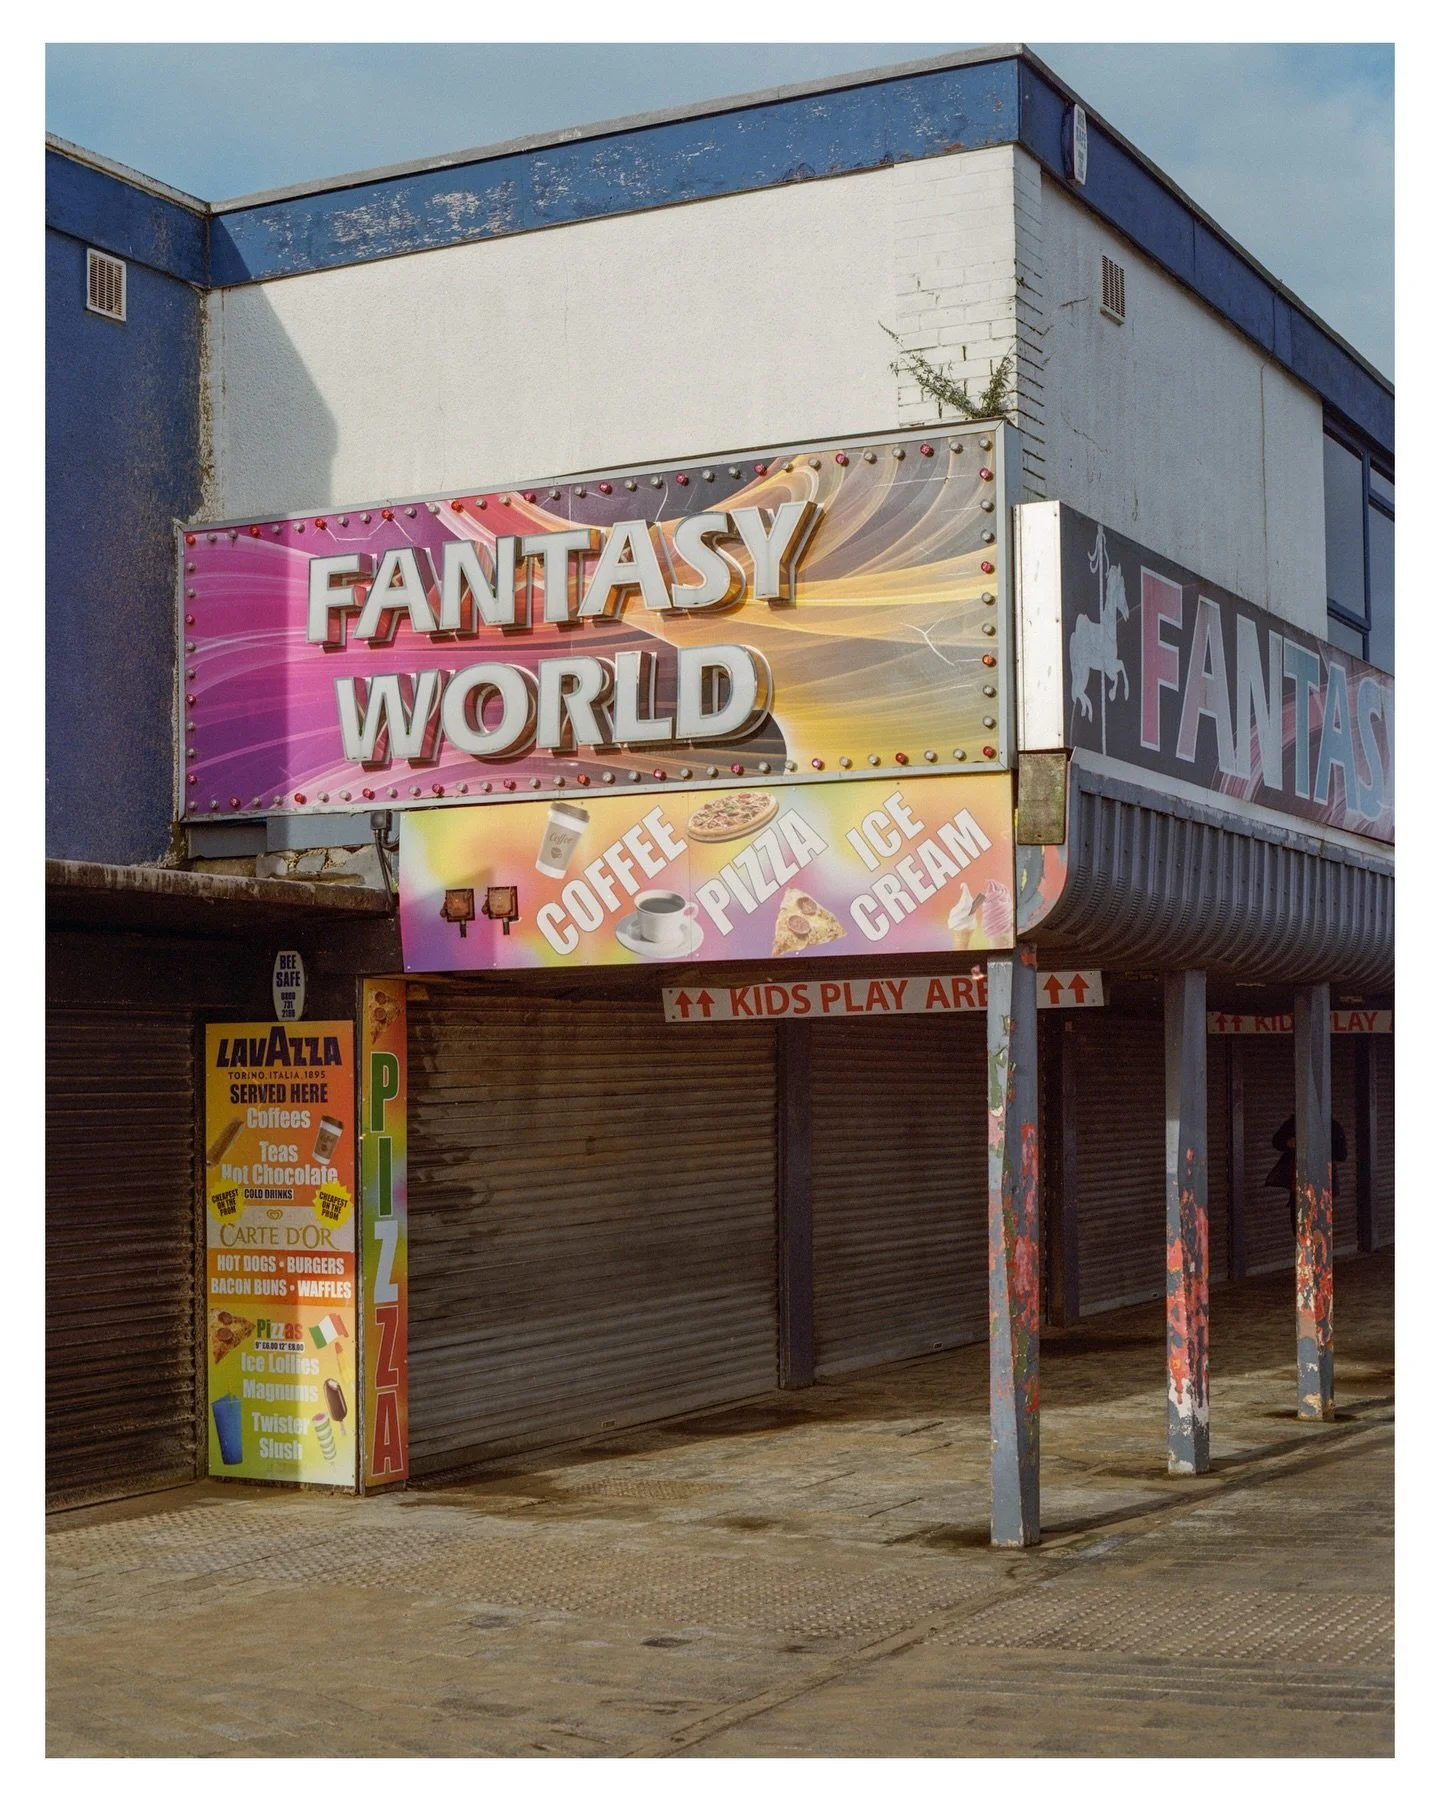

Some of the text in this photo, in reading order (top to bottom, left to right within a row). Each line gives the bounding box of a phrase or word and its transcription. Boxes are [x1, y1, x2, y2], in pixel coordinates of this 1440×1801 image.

[306, 500, 821, 647] FANTASY
[334, 643, 773, 766] WORLD
[549, 831, 574, 845] Coffee
[845, 790, 926, 872] ICE
[535, 805, 689, 957] COFFEE
[694, 807, 830, 937] PIZZA
[849, 807, 994, 944] CREAM
[280, 955, 297, 969] BEE
[276, 971, 300, 987] SAFE
[729, 976, 988, 1017] KIDS PLAY ARE
[1255, 1014, 1294, 1031] KID
[1331, 1012, 1378, 1031] LAY
[216, 1026, 343, 1067] LAVAZZA
[304, 1070, 326, 1079] 1895
[230, 1083, 328, 1104] SERVED HERE
[247, 1107, 311, 1129] Coffees
[258, 1141, 298, 1162] Teas
[221, 1164, 338, 1186] Hot Chocolate
[211, 1188, 239, 1204] CHEAPEST
[217, 1198, 237, 1209] ON THE
[244, 1188, 293, 1199] COLD DRINKS
[319, 1191, 348, 1208] CHEAPEST
[220, 1206, 237, 1217] PROM
[322, 1200, 342, 1214] ON THE
[322, 1209, 339, 1221] PROM
[220, 1223, 340, 1250] CARTE D'OR
[217, 1255, 344, 1275] HOT DOGS BURGERS
[370, 1051, 404, 1477] PIZZA
[211, 1279, 351, 1298] BACON BUNS WAFFLES
[256, 1319, 303, 1340] Pizzas
[241, 1353, 320, 1375] Ice Lollies
[242, 1379, 319, 1402] Magnums
[251, 1412, 310, 1435] Twister
[259, 1438, 303, 1460] Slush
